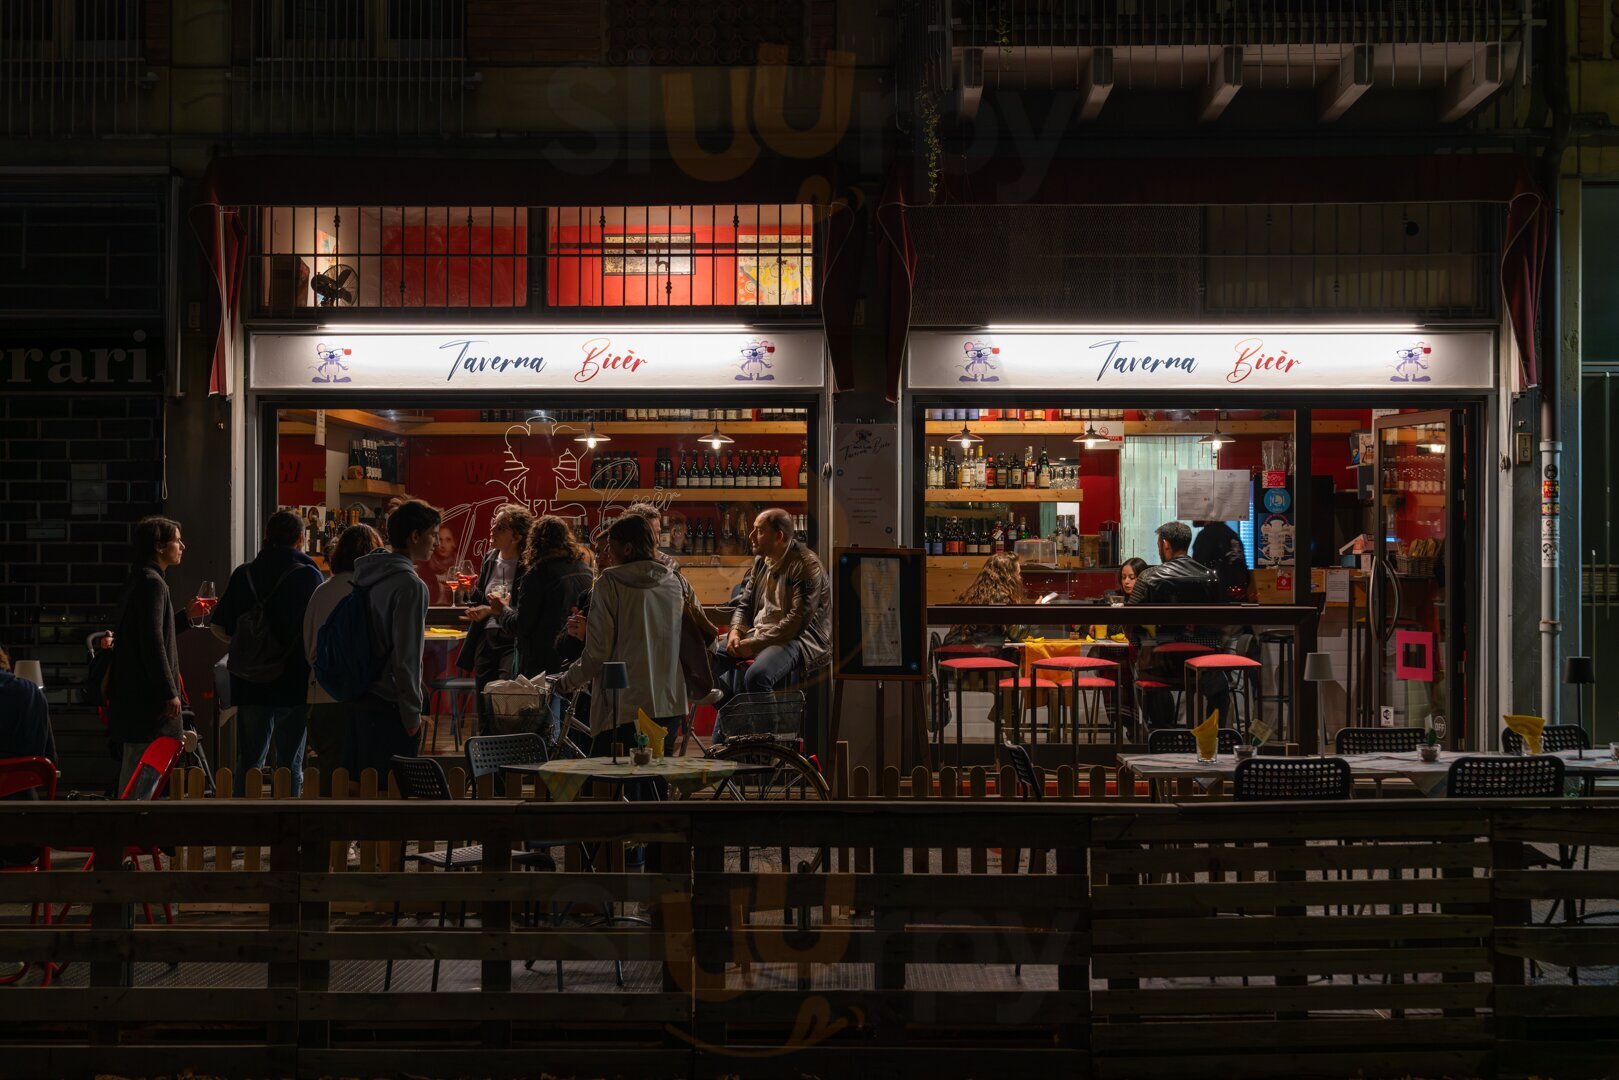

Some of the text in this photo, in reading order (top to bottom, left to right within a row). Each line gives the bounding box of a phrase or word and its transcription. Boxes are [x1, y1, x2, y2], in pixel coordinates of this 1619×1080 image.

[0, 329, 152, 384] rari
[438, 337, 648, 383] Taverna Bicèr
[1088, 337, 1301, 384] Taverna Bicèr
